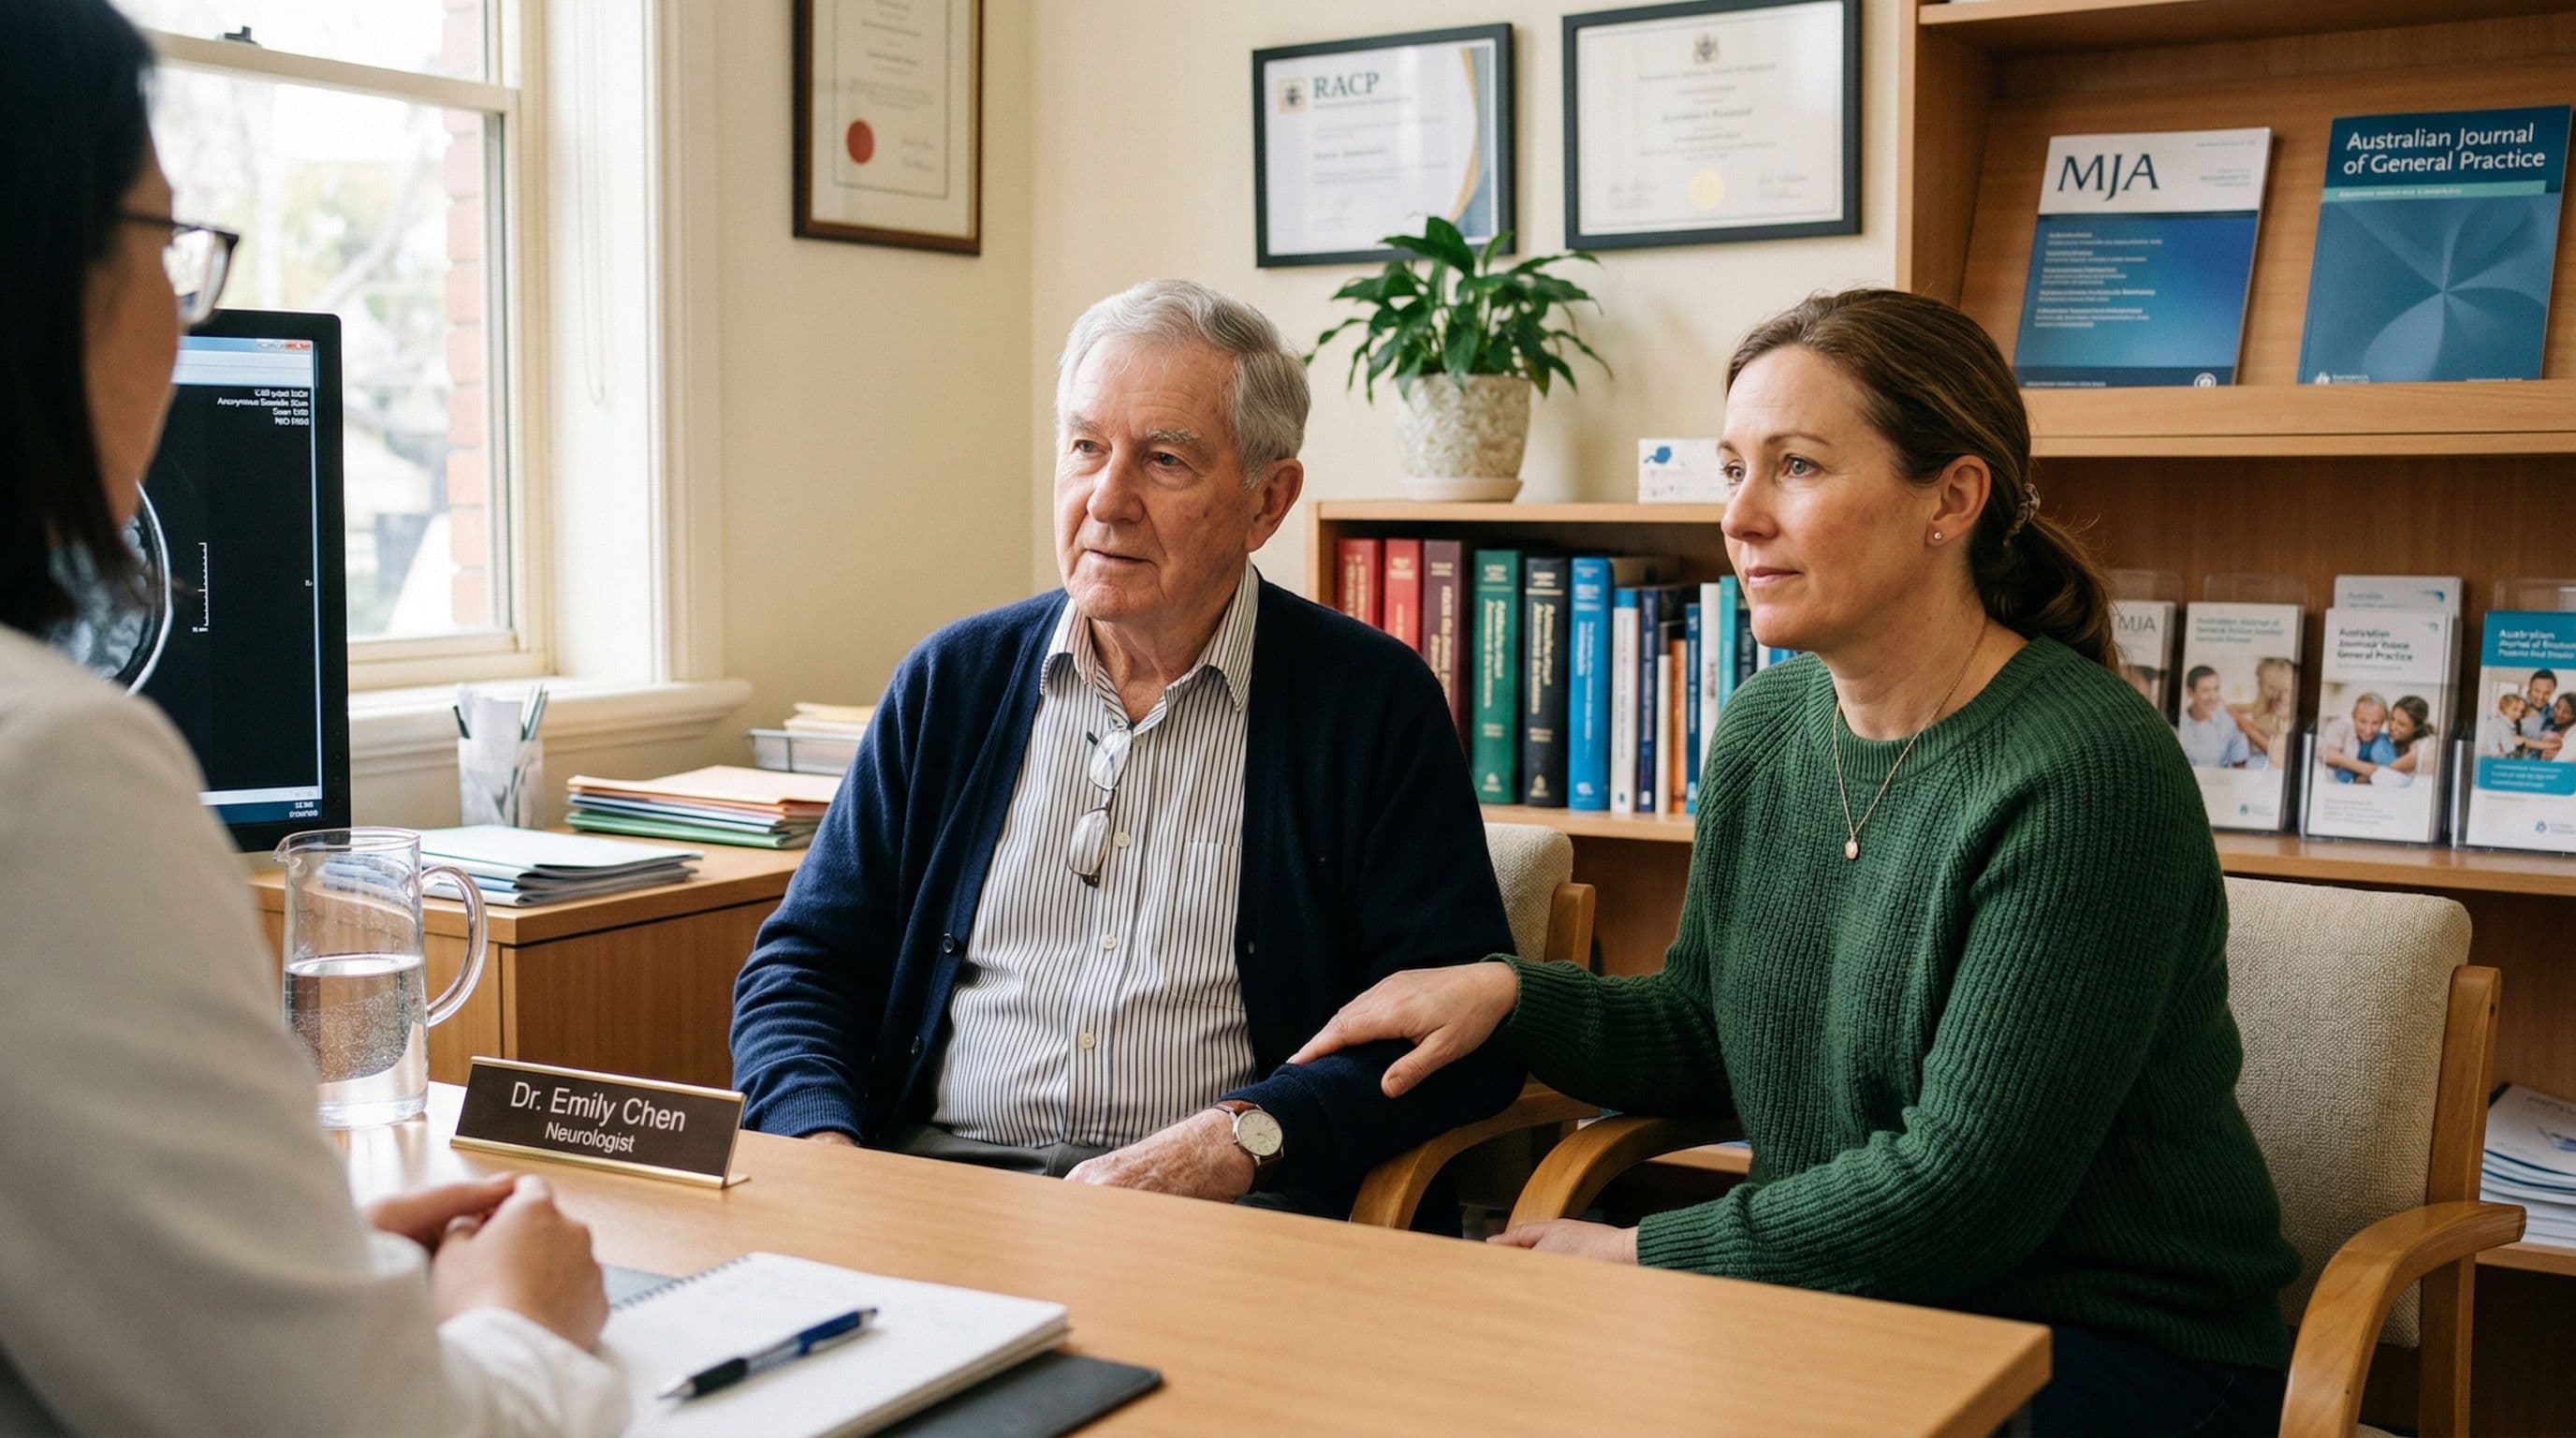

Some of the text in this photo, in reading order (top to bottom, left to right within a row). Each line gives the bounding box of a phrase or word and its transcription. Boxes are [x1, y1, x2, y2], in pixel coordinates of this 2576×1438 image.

[1313, 71, 1380, 98] RACP
[2347, 123, 2534, 151] Australian Journal
[2343, 149, 2546, 175] of General Practice
[2057, 153, 2159, 201] MJA
[2118, 614, 2156, 632] MJA
[510, 1081, 686, 1132] Dr. Emily Chen
[545, 1121, 636, 1153] Neurologist
